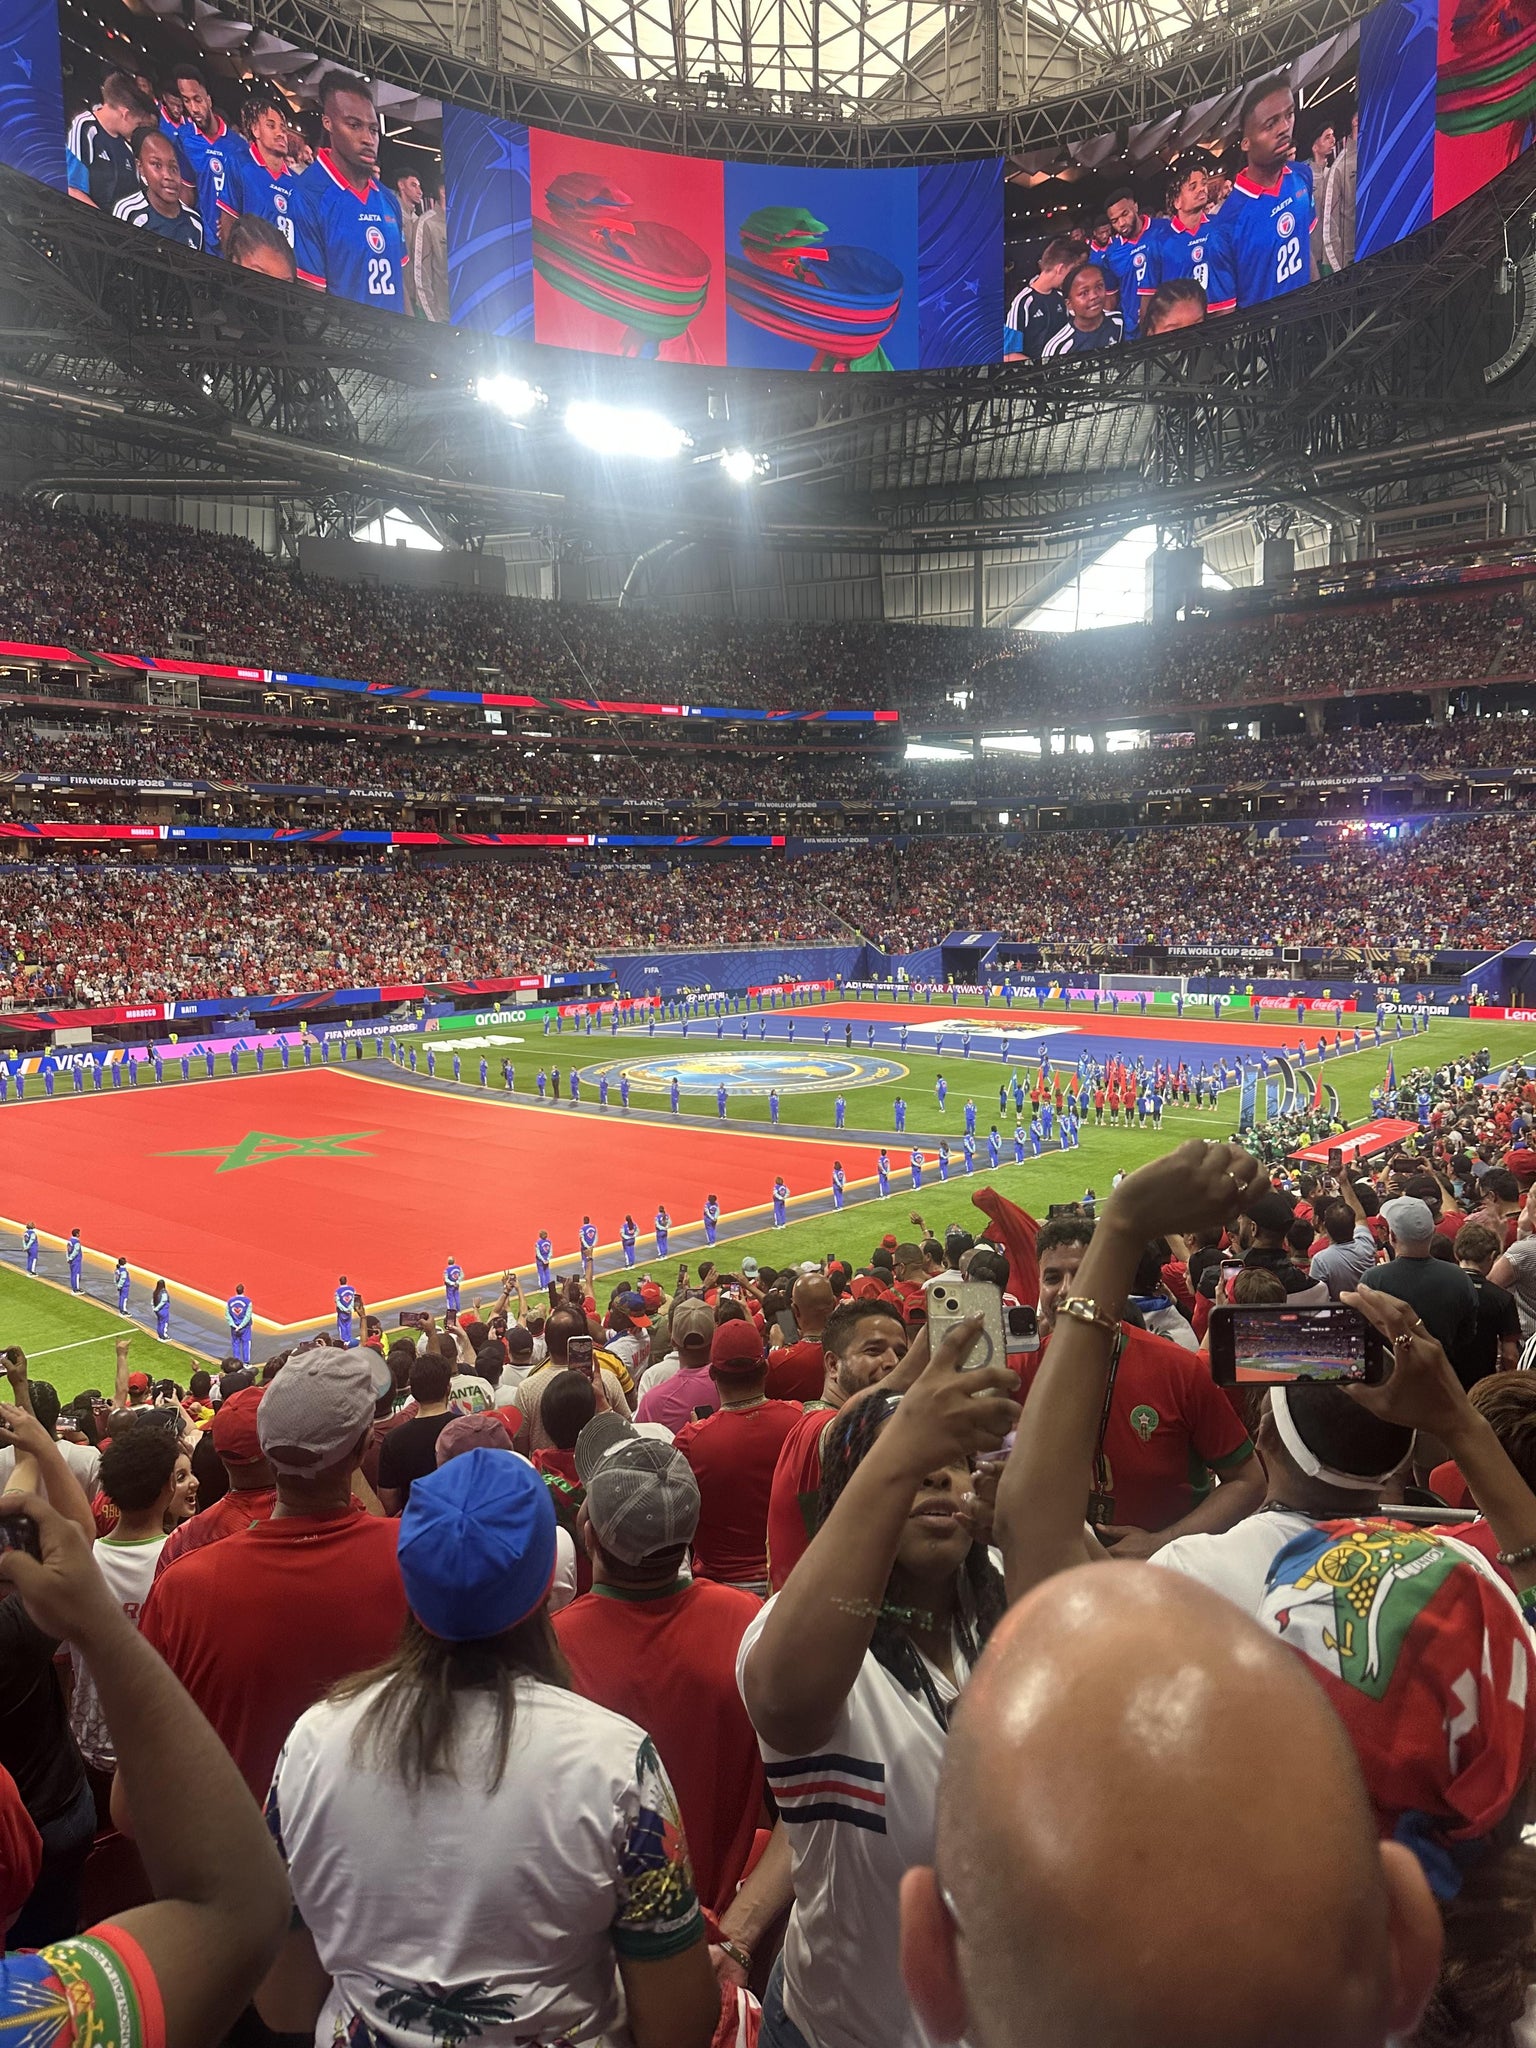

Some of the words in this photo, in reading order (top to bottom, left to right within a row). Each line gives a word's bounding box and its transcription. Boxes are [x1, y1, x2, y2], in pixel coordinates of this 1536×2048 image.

[358, 213, 382, 222] SAETA
[1277, 237, 1302, 284] 22
[368, 258, 396, 295] 22
[70, 776, 89, 784] FIFA
[89, 777, 119, 786] WORLD
[120, 778, 137, 786] CUP
[137, 779, 165, 787] 2026
[349, 789, 394, 798] ATLANTA
[1147, 787, 1192, 796] ATLANTA
[1167, 947, 1188, 955] FIFA
[1188, 947, 1220, 956] WORLD
[1221, 947, 1240, 956] CUP
[1240, 948, 1274, 956] 2026
[1012, 986, 1037, 998] VISA
[1399, 1004, 1450, 1016] HYUNDAI
[475, 1010, 527, 1026] aramco
[324, 1031, 343, 1040] FIFA
[343, 1028, 372, 1038] WORLD
[373, 1026, 389, 1035] CUP
[52, 1052, 96, 1071] VISA
